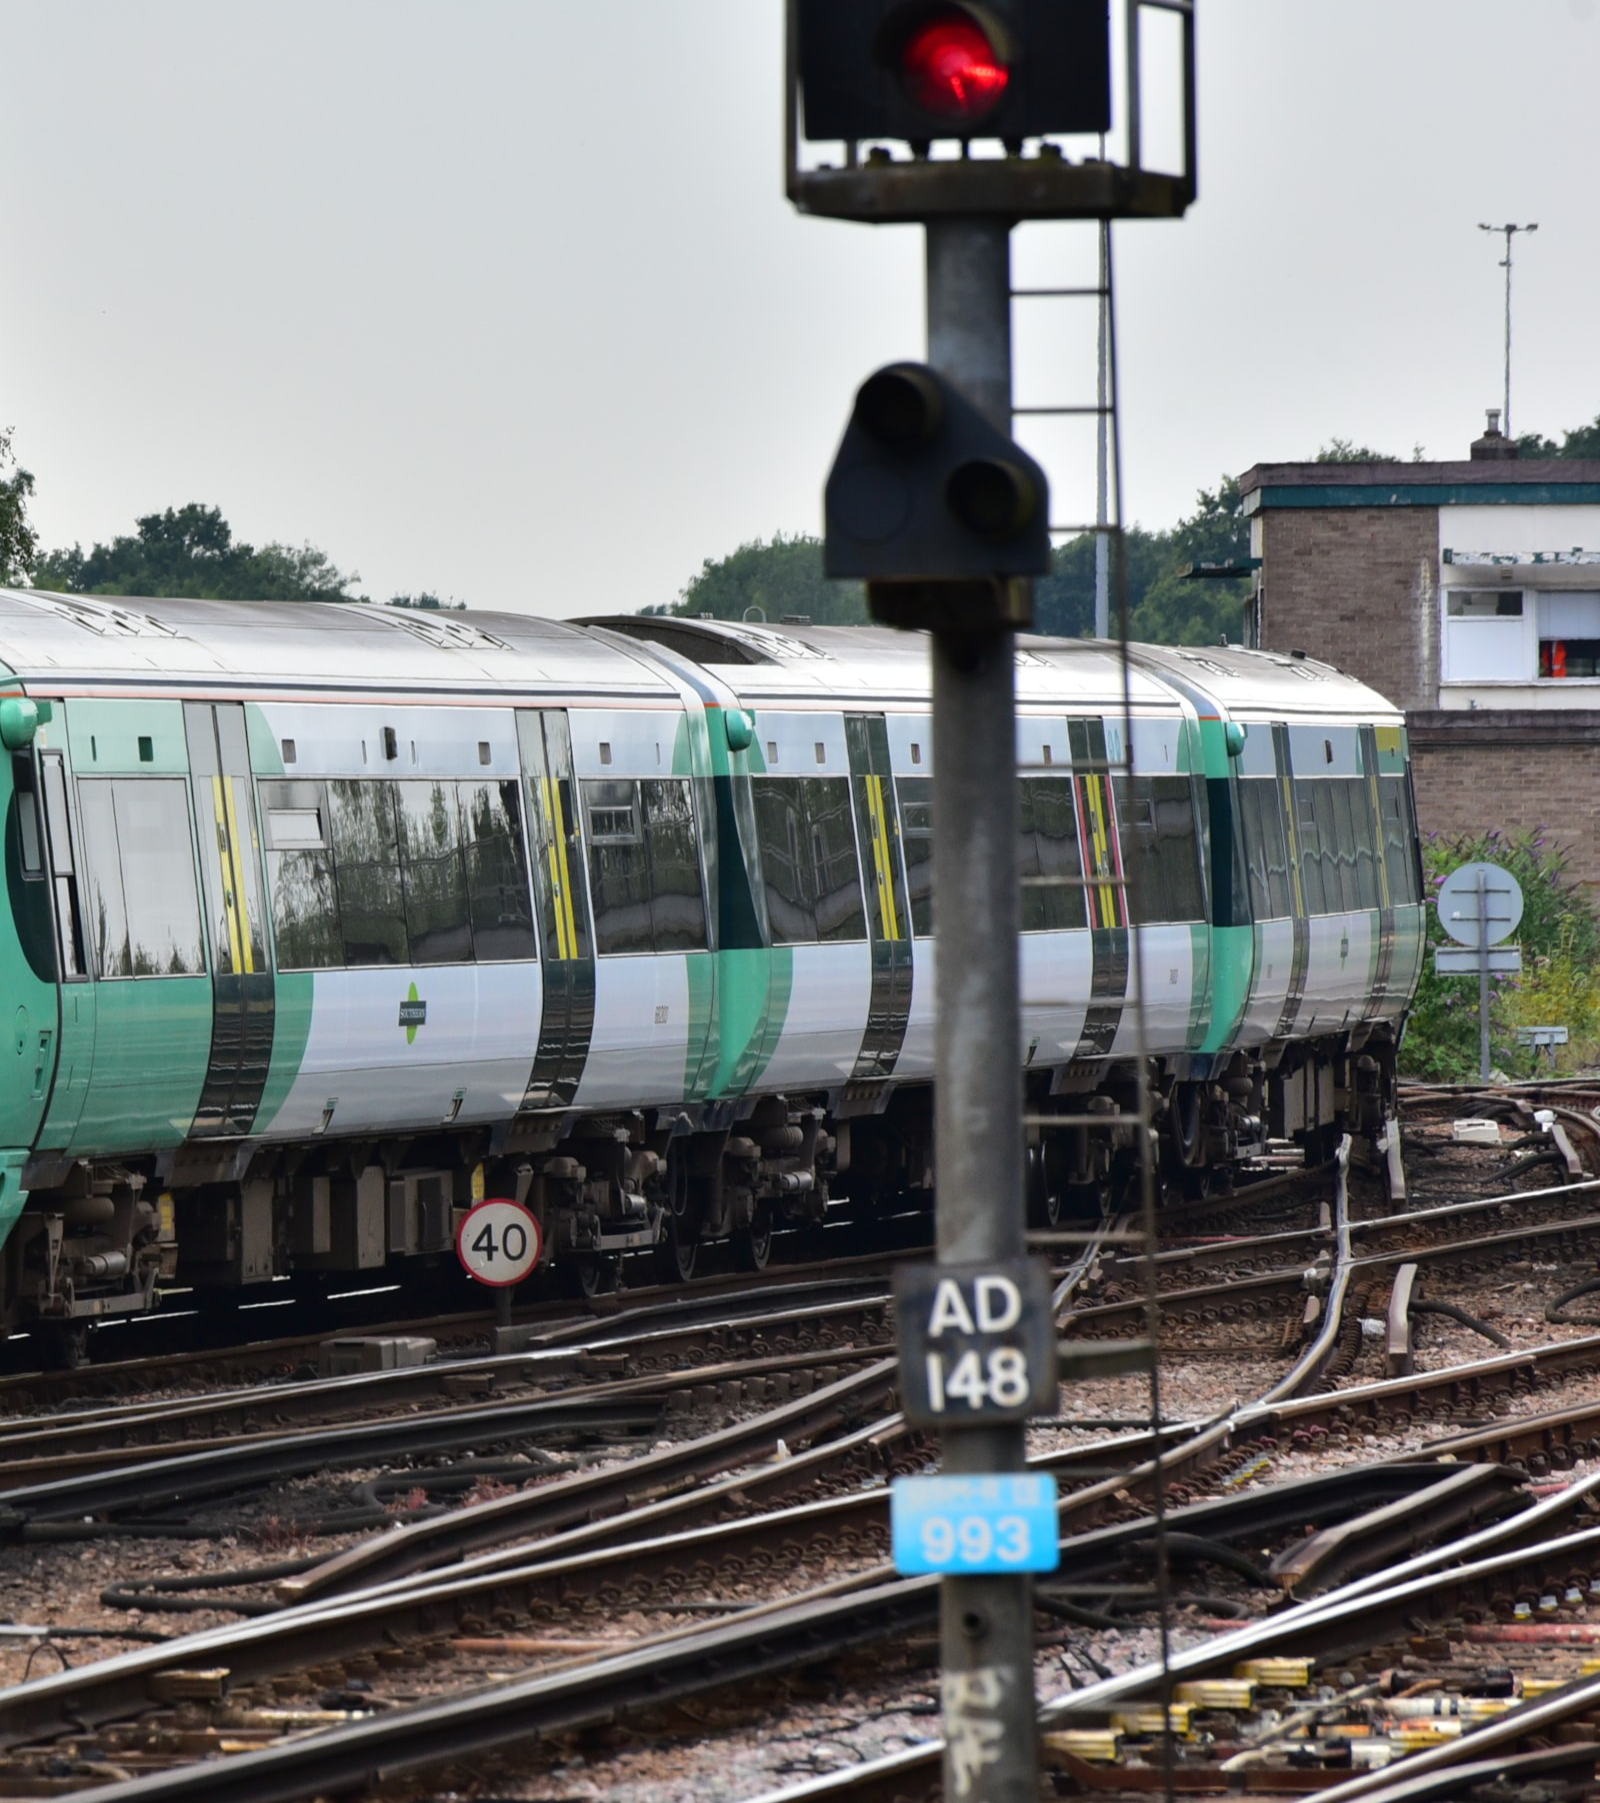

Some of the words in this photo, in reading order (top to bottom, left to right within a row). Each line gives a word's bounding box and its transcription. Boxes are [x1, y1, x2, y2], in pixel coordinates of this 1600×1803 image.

[471, 1223, 527, 1262] 40
[928, 1275, 1022, 1337] AD
[926, 1347, 1029, 1412] 148
[921, 1515, 1031, 1564] 993
